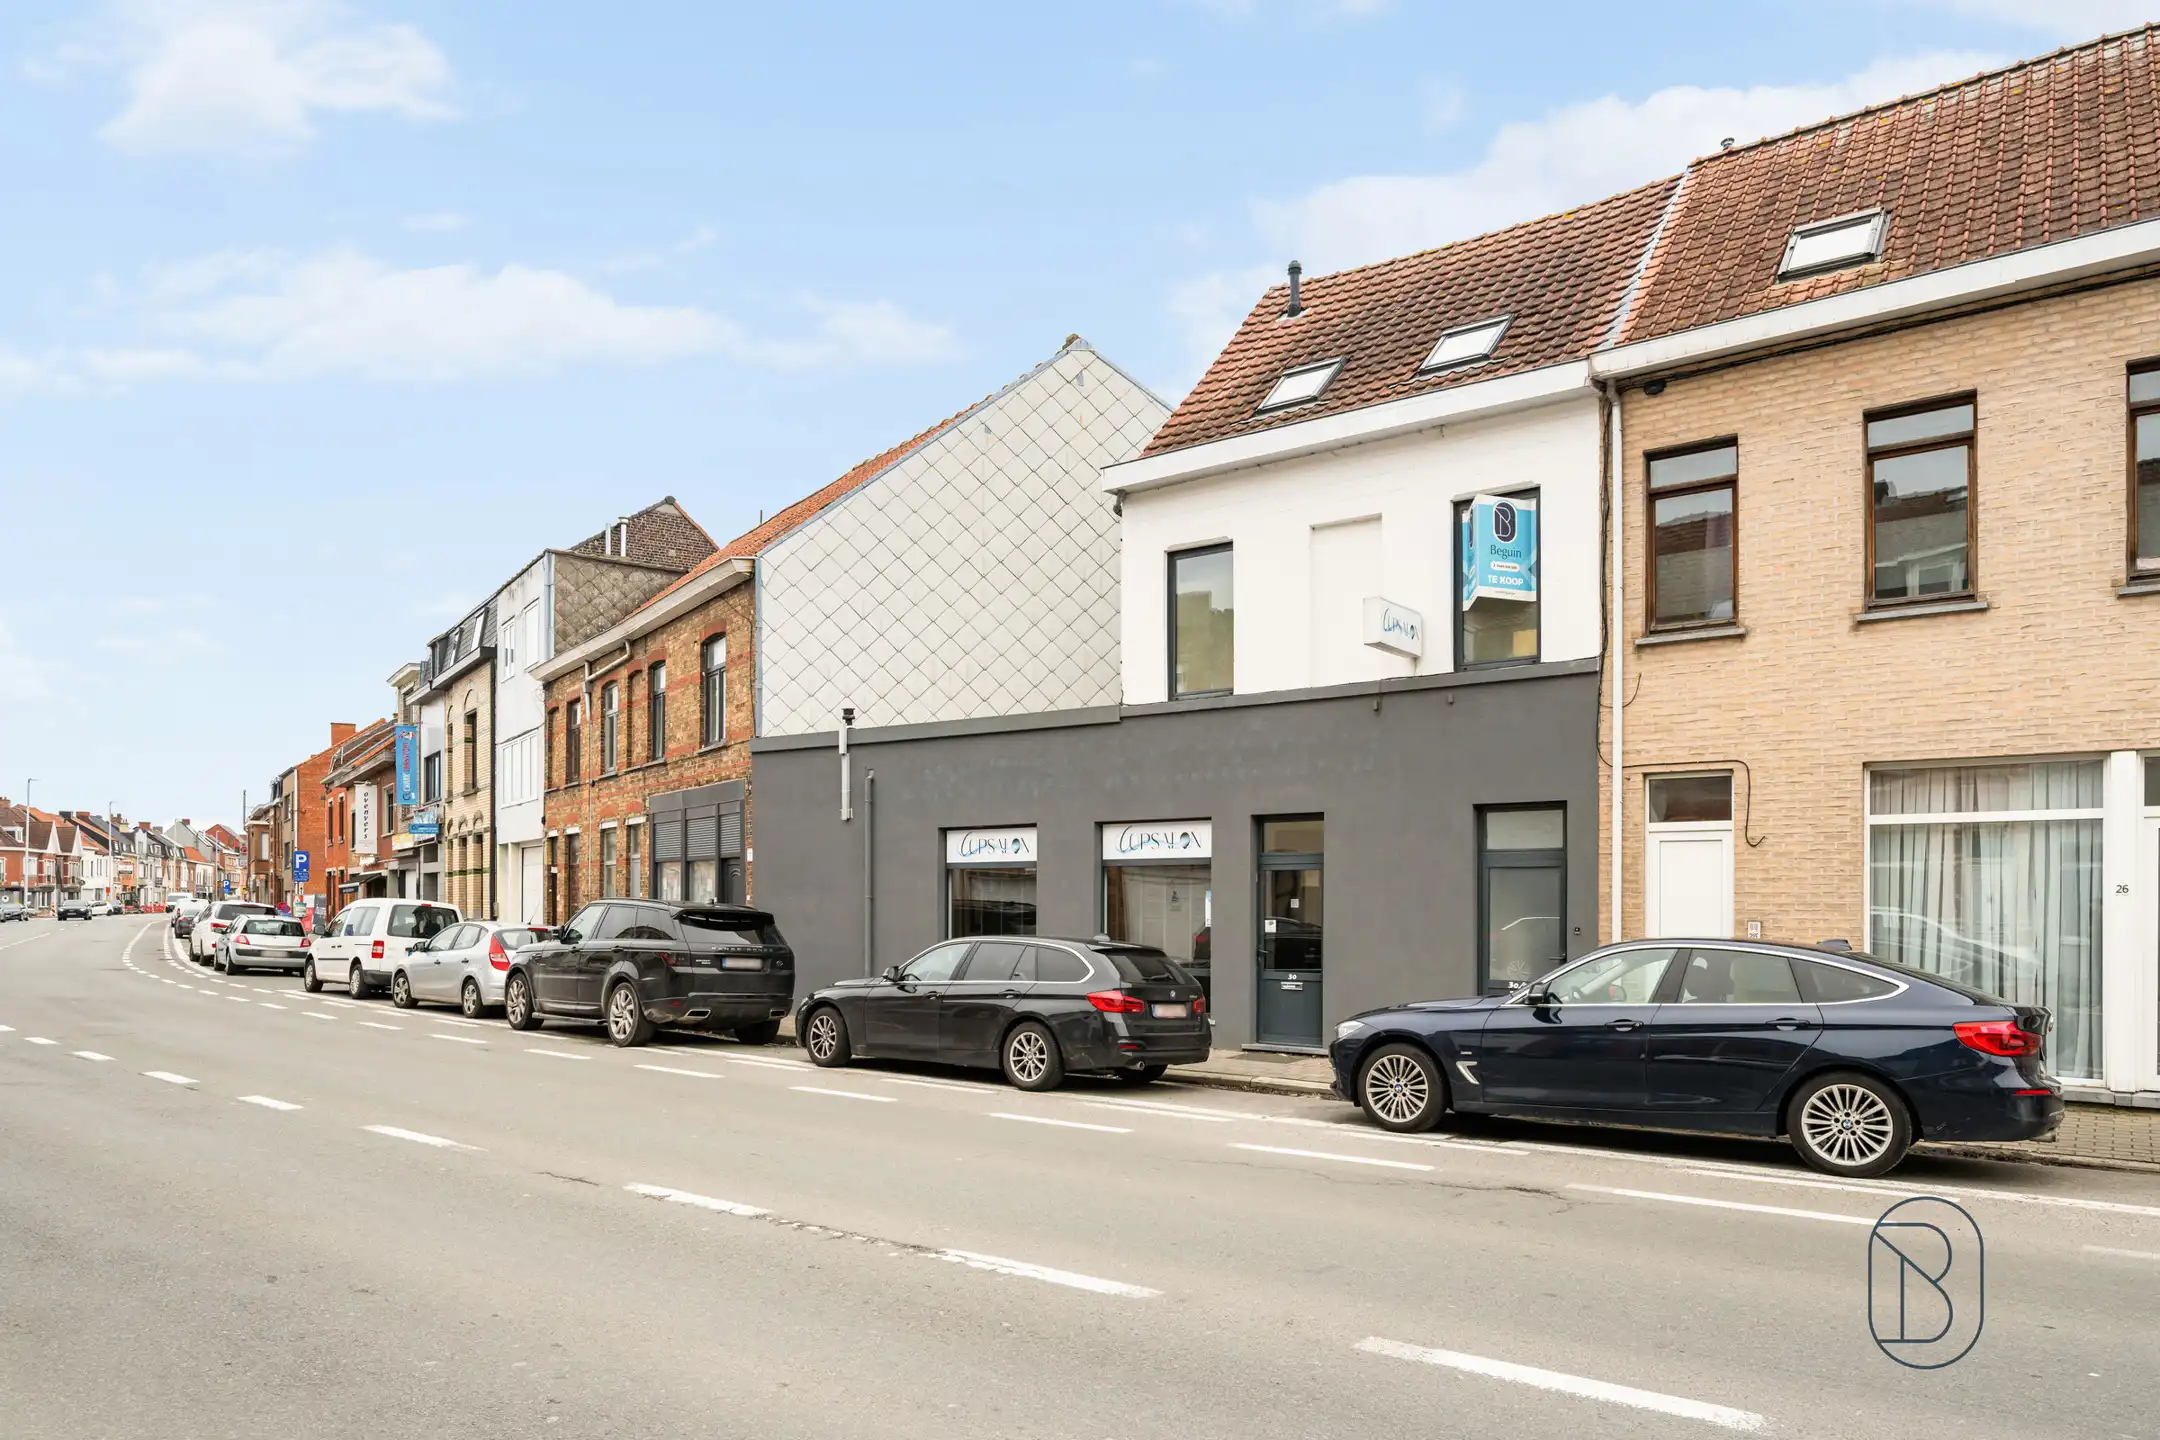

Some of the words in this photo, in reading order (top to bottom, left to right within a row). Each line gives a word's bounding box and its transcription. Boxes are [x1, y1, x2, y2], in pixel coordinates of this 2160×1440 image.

[1490, 544, 1522, 560] Beguin
[1487, 574, 1498, 584] TE
[1500, 576, 1524, 586] KOOP
[295, 854, 307, 869] P
[223, 880, 230, 888] P
[2115, 884, 2130, 894] 26
[1287, 973, 1298, 981] 30
